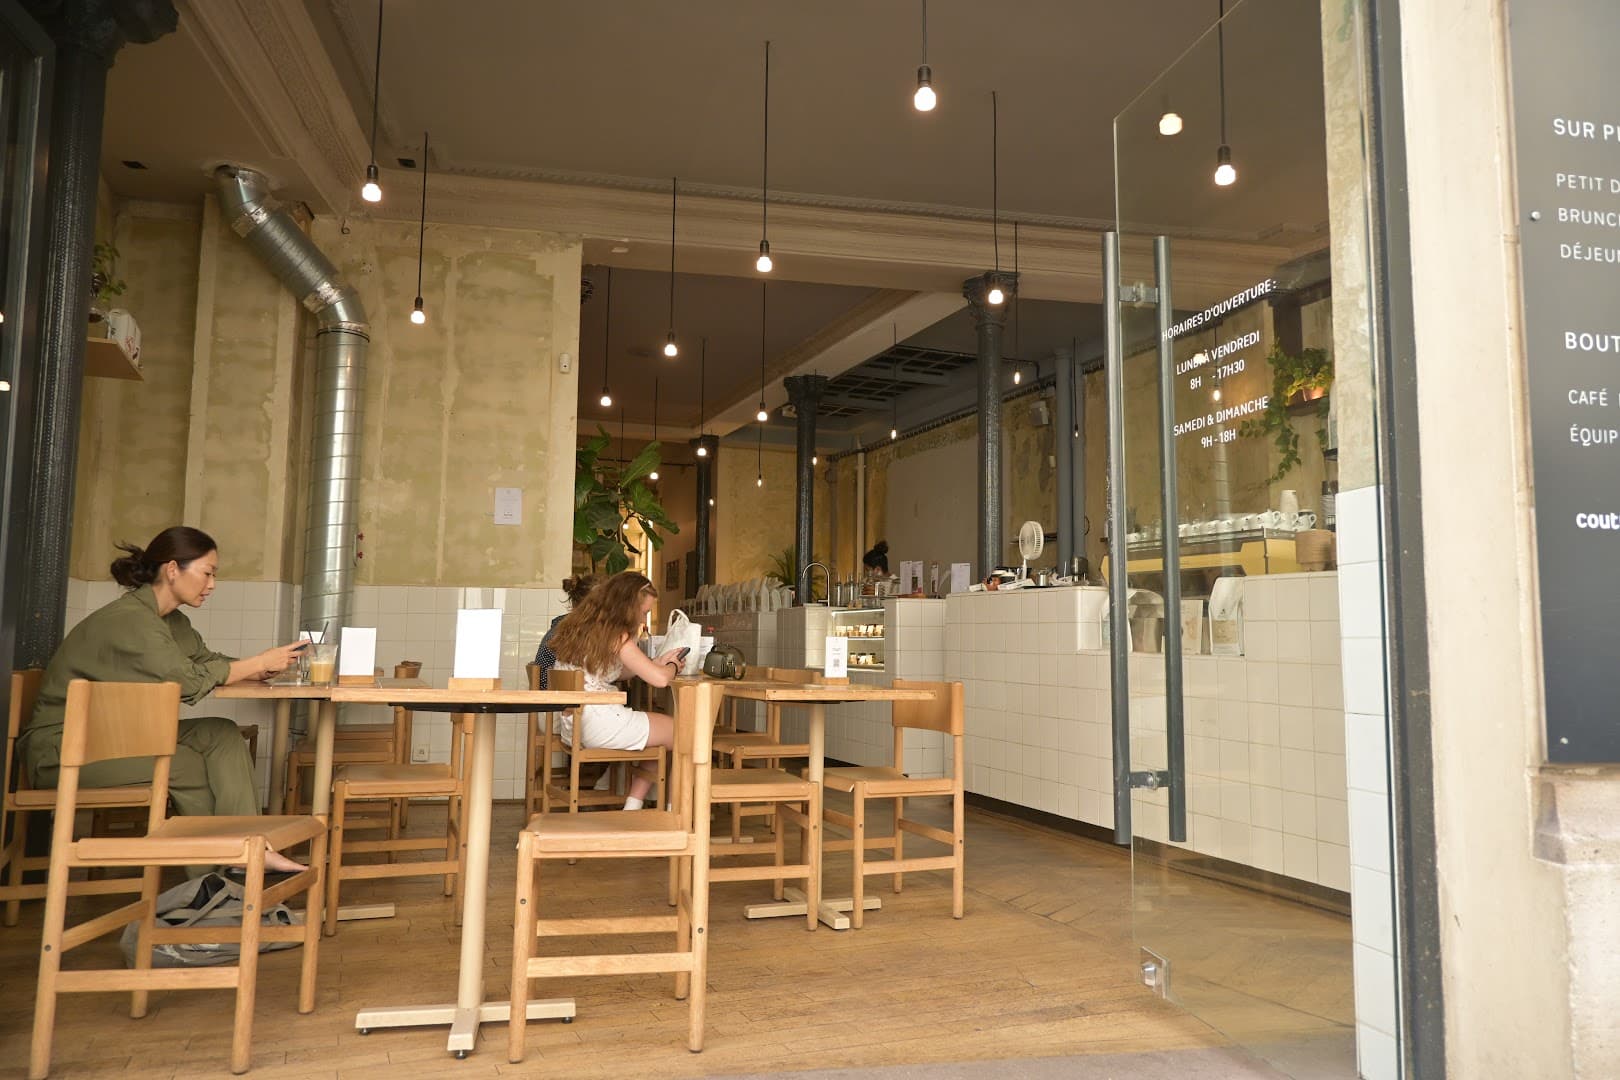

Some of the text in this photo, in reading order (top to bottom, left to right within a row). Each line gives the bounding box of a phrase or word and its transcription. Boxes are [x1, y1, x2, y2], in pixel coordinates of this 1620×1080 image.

[1553, 118, 1595, 139] SUR
[1556, 173, 1603, 191] PETIT
[1558, 207, 1620, 227] BRUNC
[1161, 313, 1204, 342] HORAIRES
[1210, 330, 1260, 361] VENDREDI
[1190, 376, 1202, 390] 8H
[1217, 359, 1245, 379] 17H30
[1568, 388, 1609, 407] CAFÉ
[1173, 395, 1269, 436] SAMEDI & DIMANCHE
[1201, 435, 1213, 448] 9H
[1219, 428, 1236, 443] 18H
[1569, 424, 1619, 447] ÉQUIP
